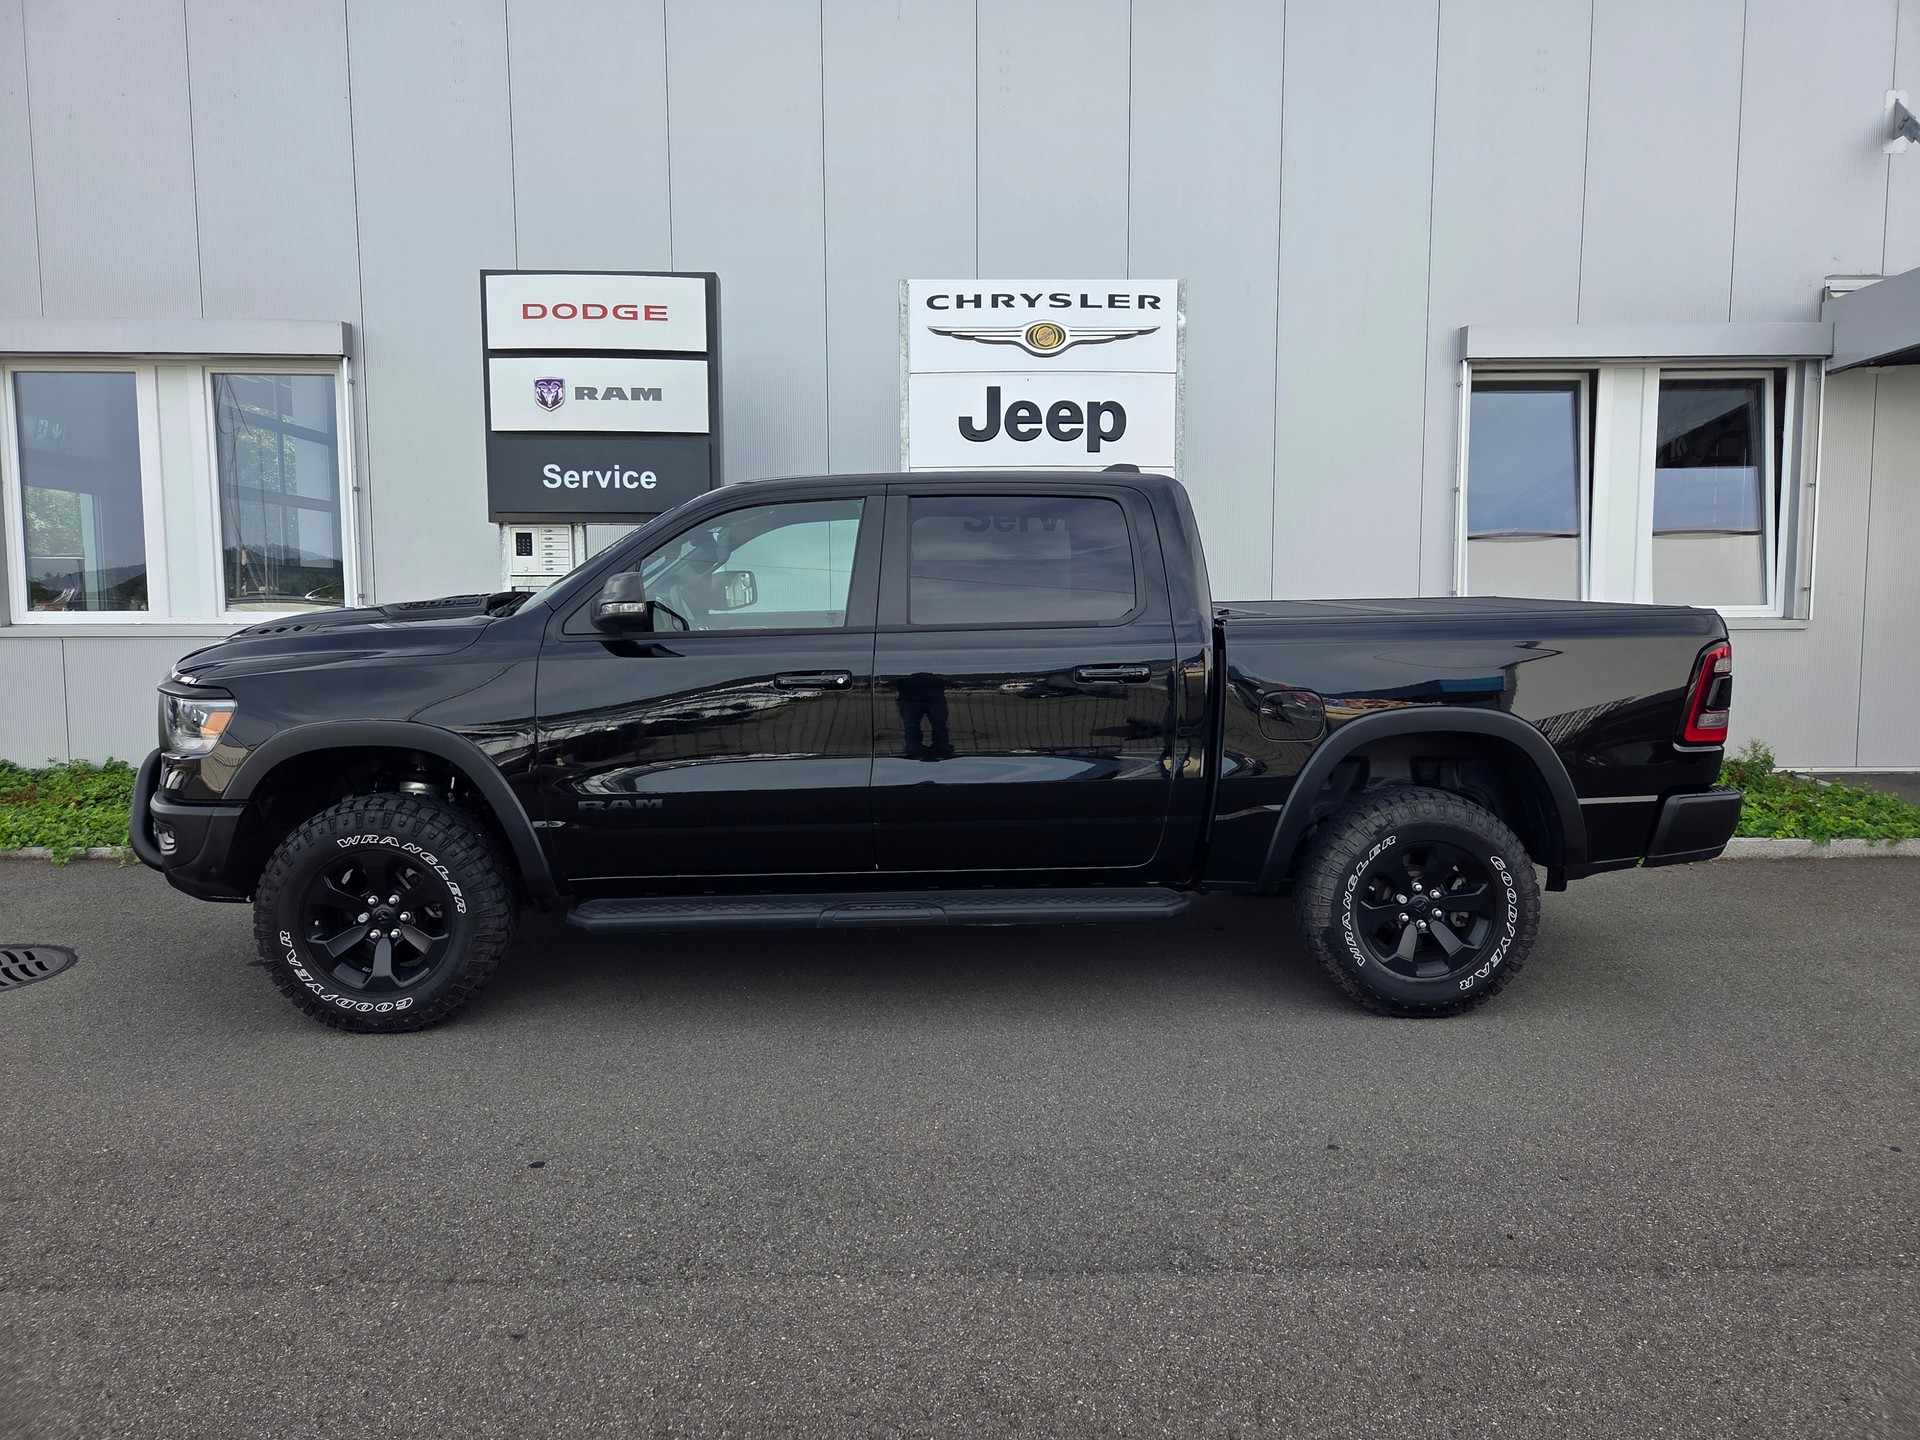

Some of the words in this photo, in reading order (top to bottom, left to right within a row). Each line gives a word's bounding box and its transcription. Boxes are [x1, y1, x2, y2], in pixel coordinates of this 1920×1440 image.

[522, 303, 668, 321] DODGE
[926, 293, 1162, 310] CHRYSLER
[575, 386, 662, 401] RAM
[958, 386, 1127, 453] Jeep
[542, 464, 657, 489] Service
[963, 514, 1069, 532] Serv
[577, 799, 663, 811] RAM
[336, 834, 467, 914] WRANGLER
[1341, 835, 1396, 967] WRANGLER
[1459, 855, 1518, 990] GOODYEAR
[279, 930, 414, 1013] GOODYEAR
